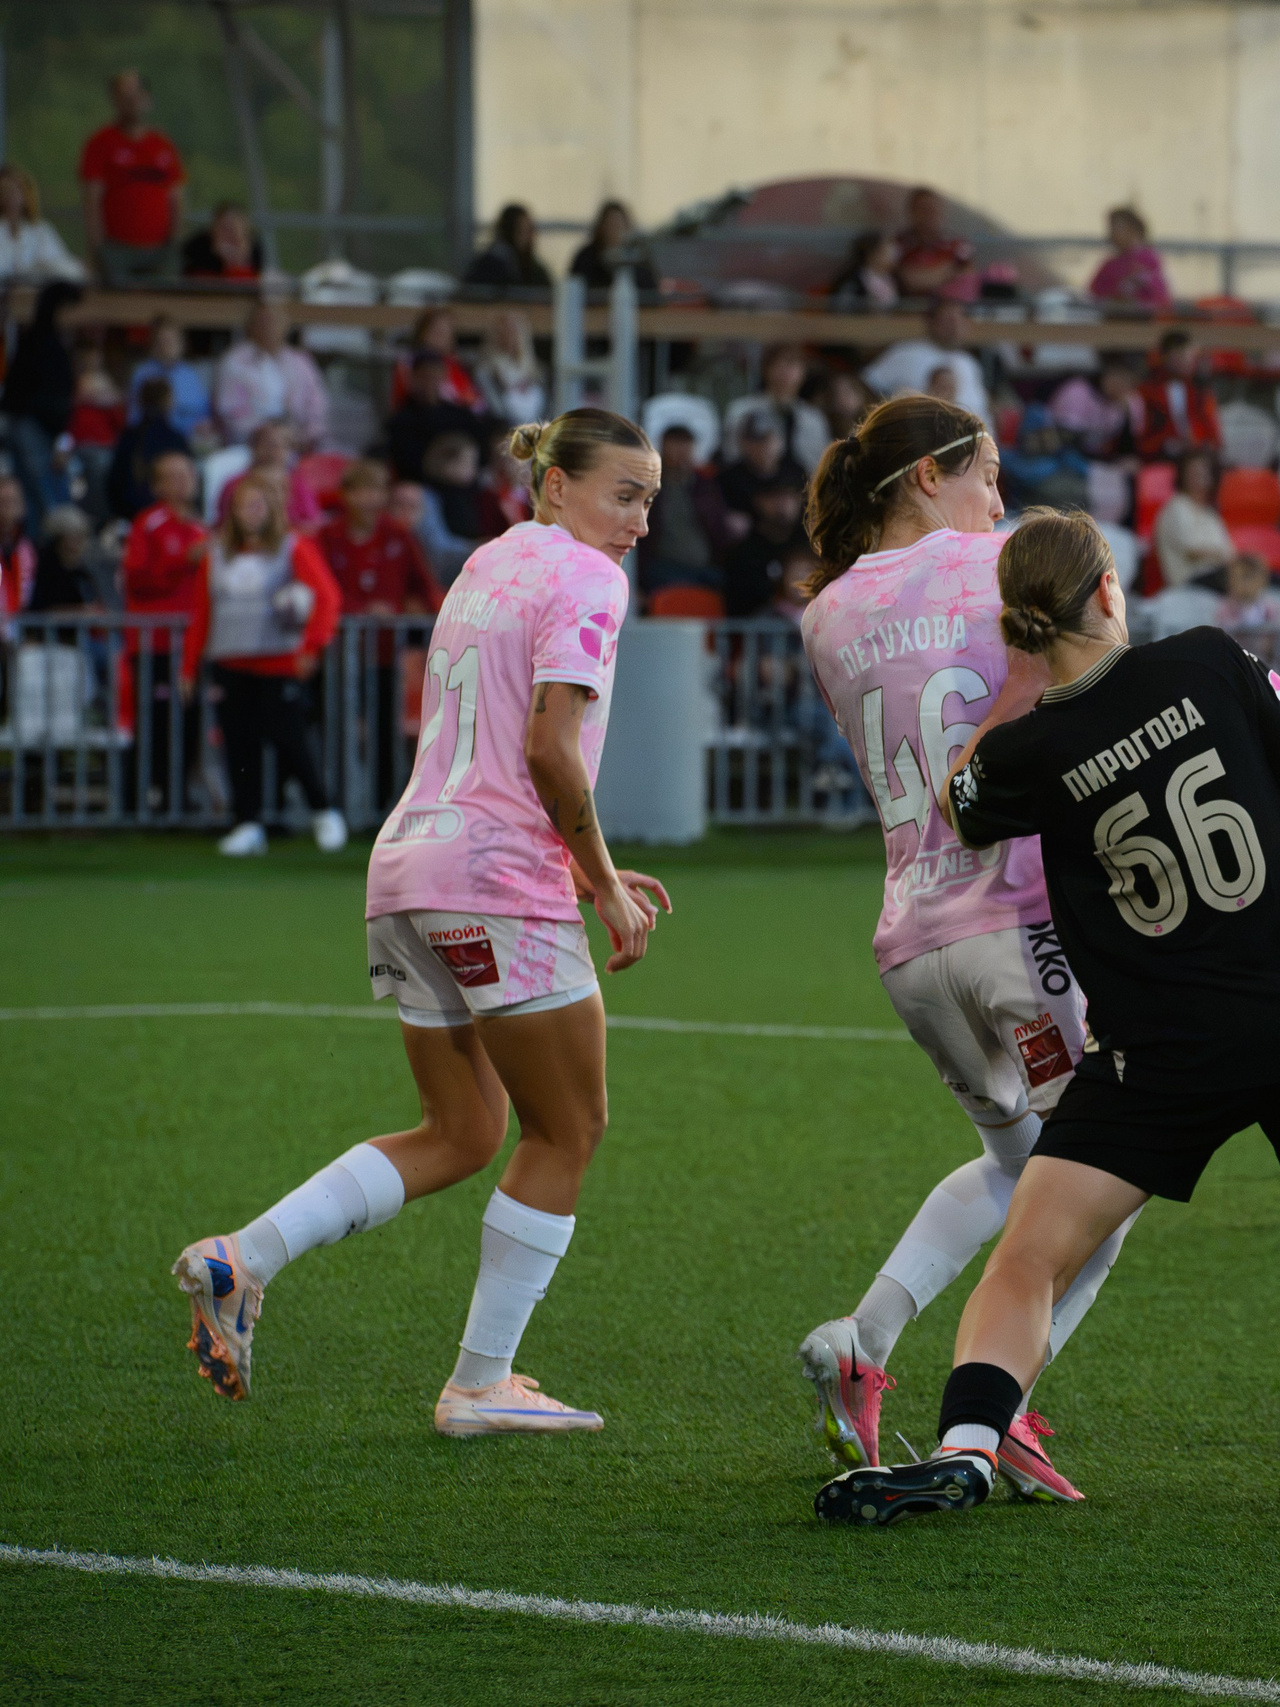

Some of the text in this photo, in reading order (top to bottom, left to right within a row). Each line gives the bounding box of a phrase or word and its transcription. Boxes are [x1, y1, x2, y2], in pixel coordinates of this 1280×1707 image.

[837, 614, 967, 680] ПЕТУХОВА
[861, 665, 991, 846] 46
[1061, 697, 1205, 802] ПИРОГОВА
[1093, 747, 1267, 937] 66
[427, 923, 487, 943] ЛУКОЙЛ
